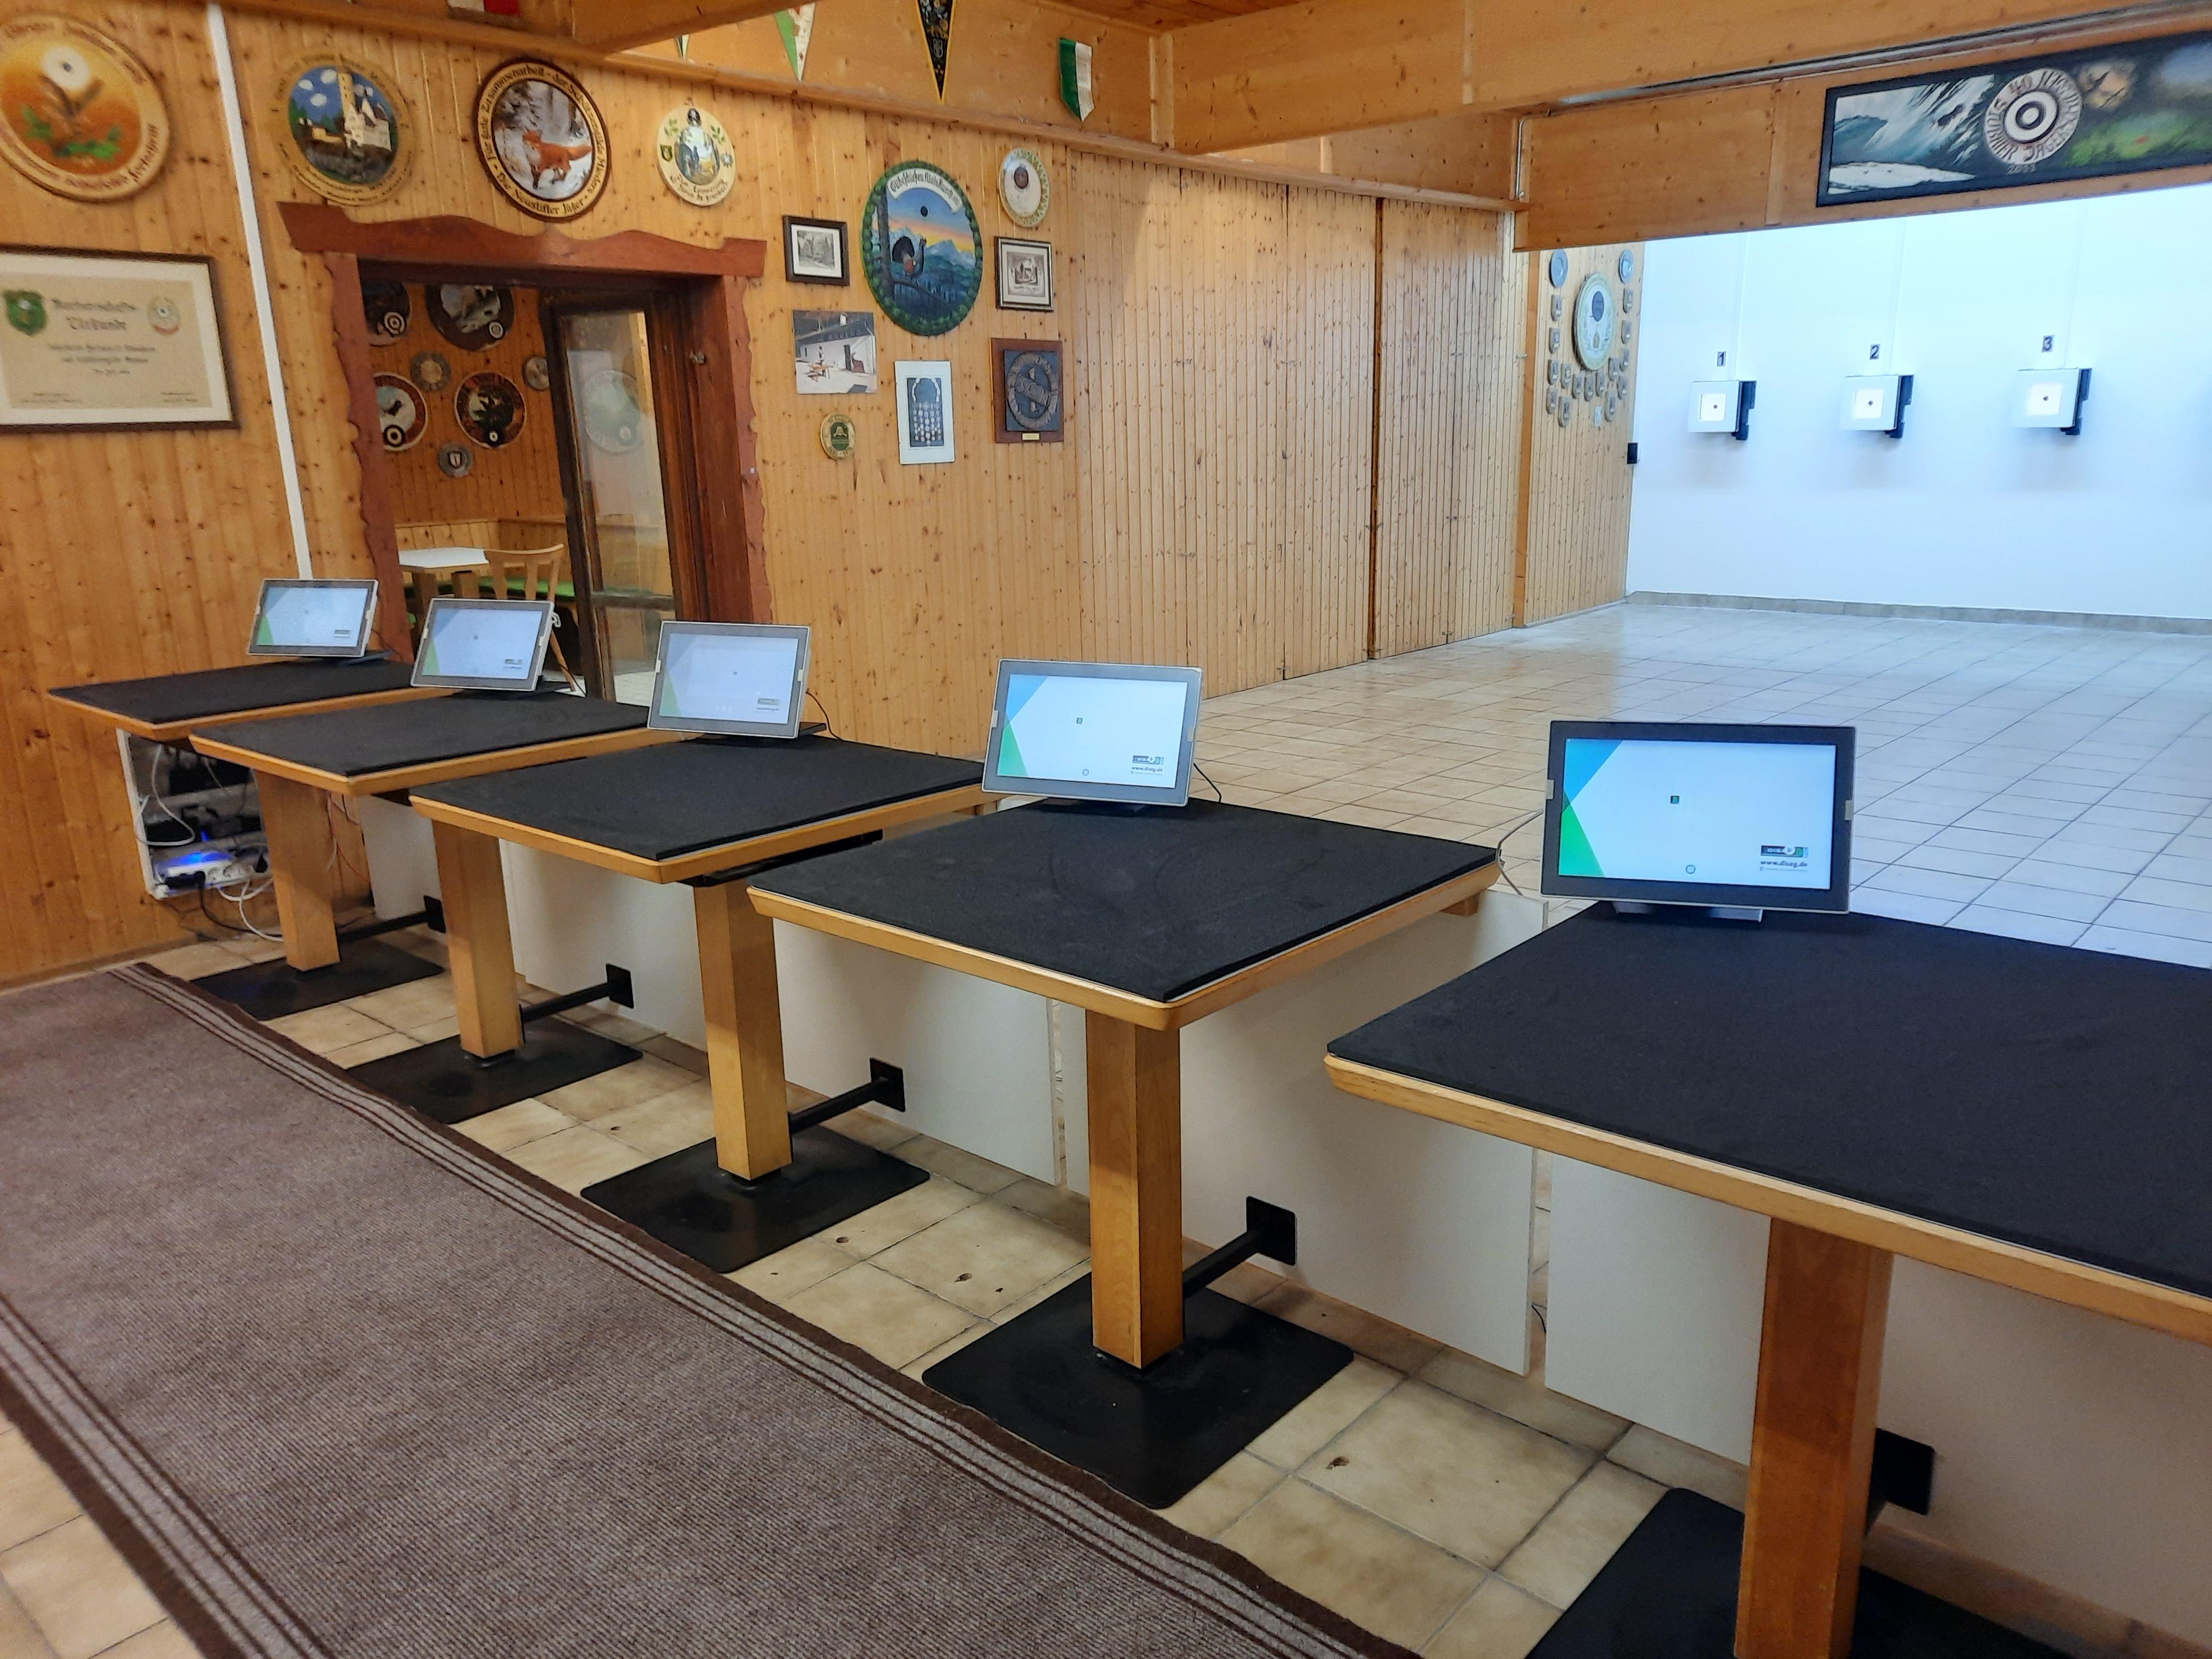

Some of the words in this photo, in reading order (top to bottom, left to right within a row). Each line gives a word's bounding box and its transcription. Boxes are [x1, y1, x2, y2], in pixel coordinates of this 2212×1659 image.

[2043, 336, 2053, 351] 3
[1718, 352, 1725, 366] 1
[1871, 344, 1879, 359] 2
